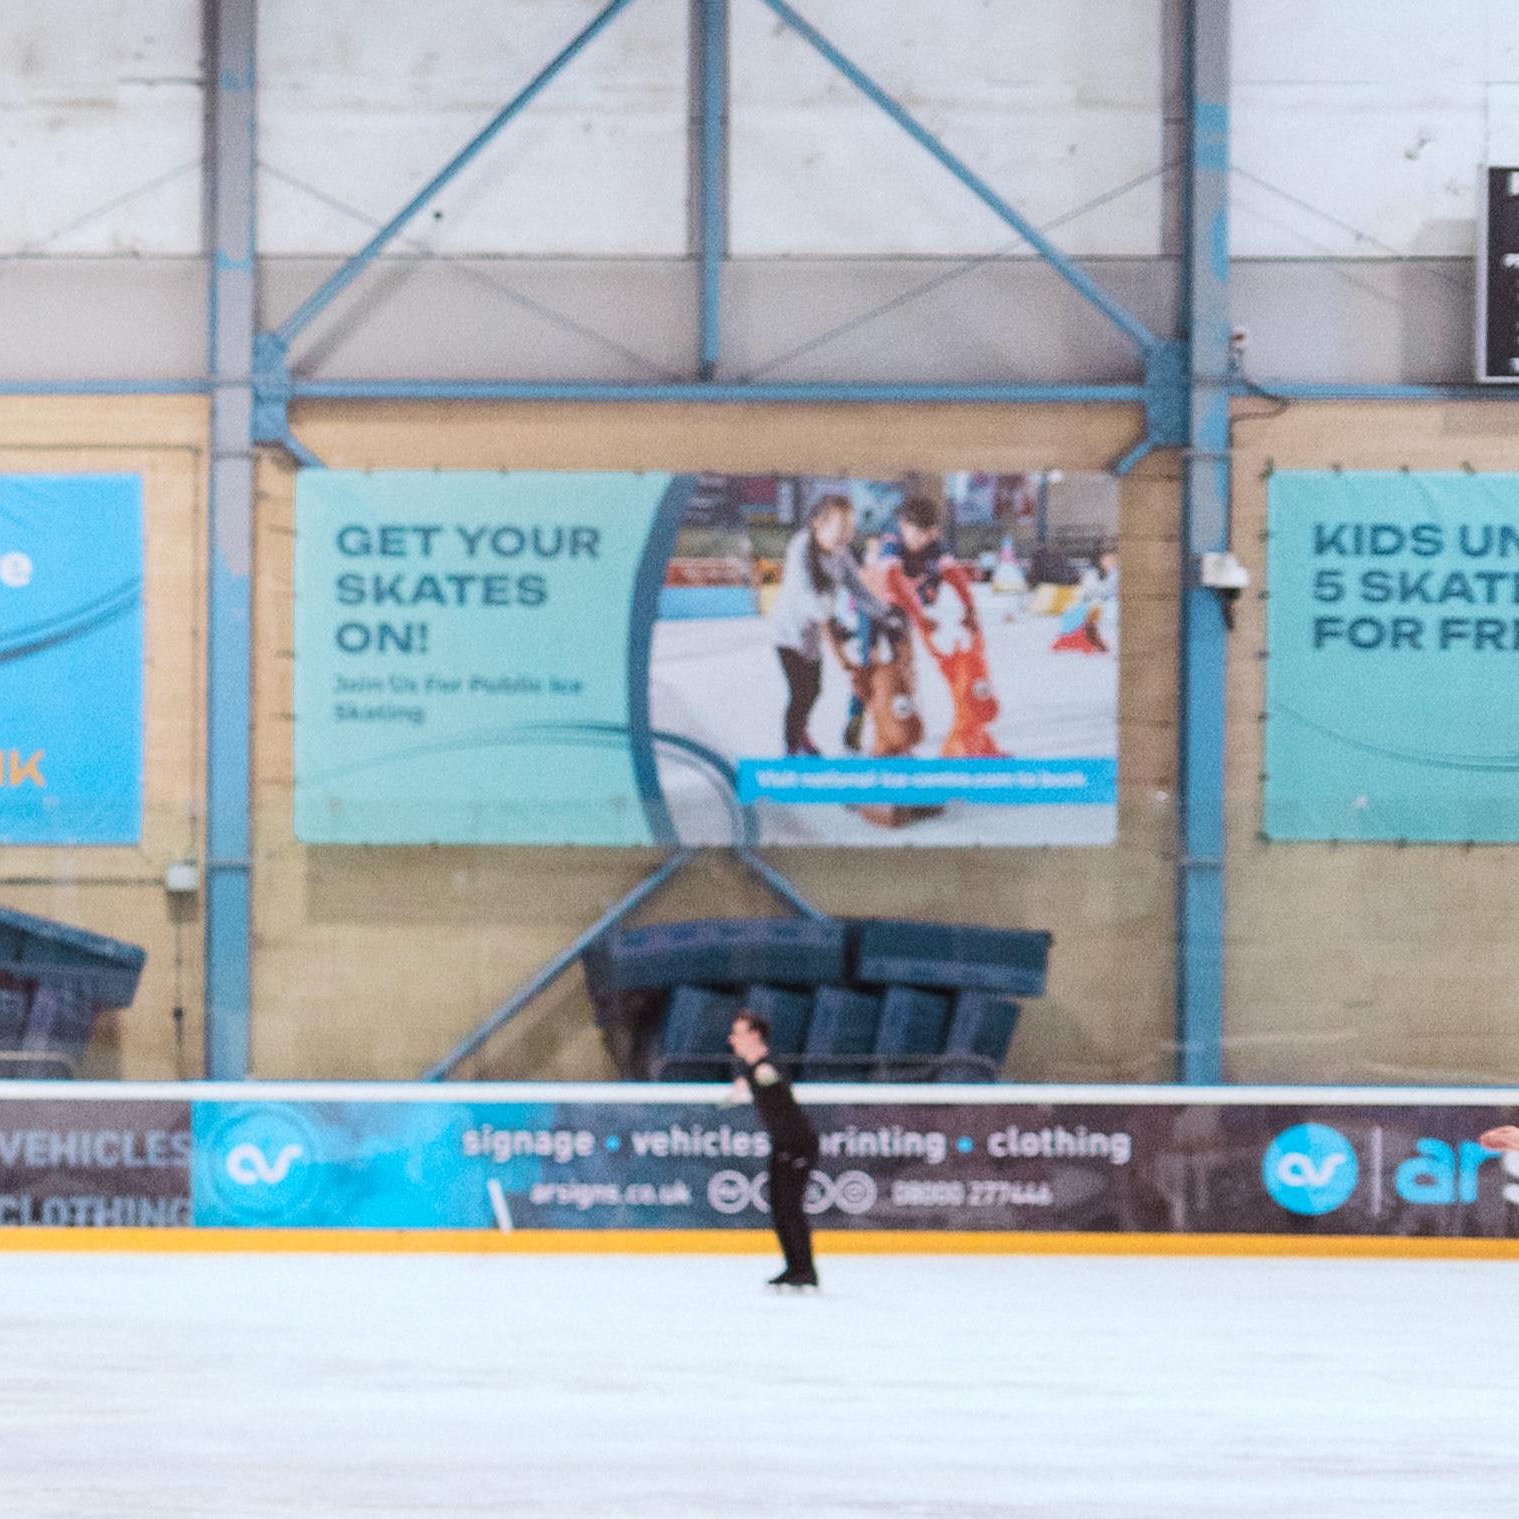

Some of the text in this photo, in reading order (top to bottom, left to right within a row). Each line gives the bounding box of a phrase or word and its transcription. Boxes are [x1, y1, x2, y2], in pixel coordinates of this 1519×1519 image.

[336, 525, 602, 559] GET YOUR
[1314, 524, 1443, 557] KIDS
[335, 573, 548, 607] SKATES
[1315, 570, 1519, 603] 5 SKAT
[335, 621, 429, 653] ON!
[1314, 617, 1519, 650] FOR FR
[463, 1125, 596, 1163] signage
[631, 1125, 772, 1157] vehicles
[987, 1124, 1132, 1165] clothing
